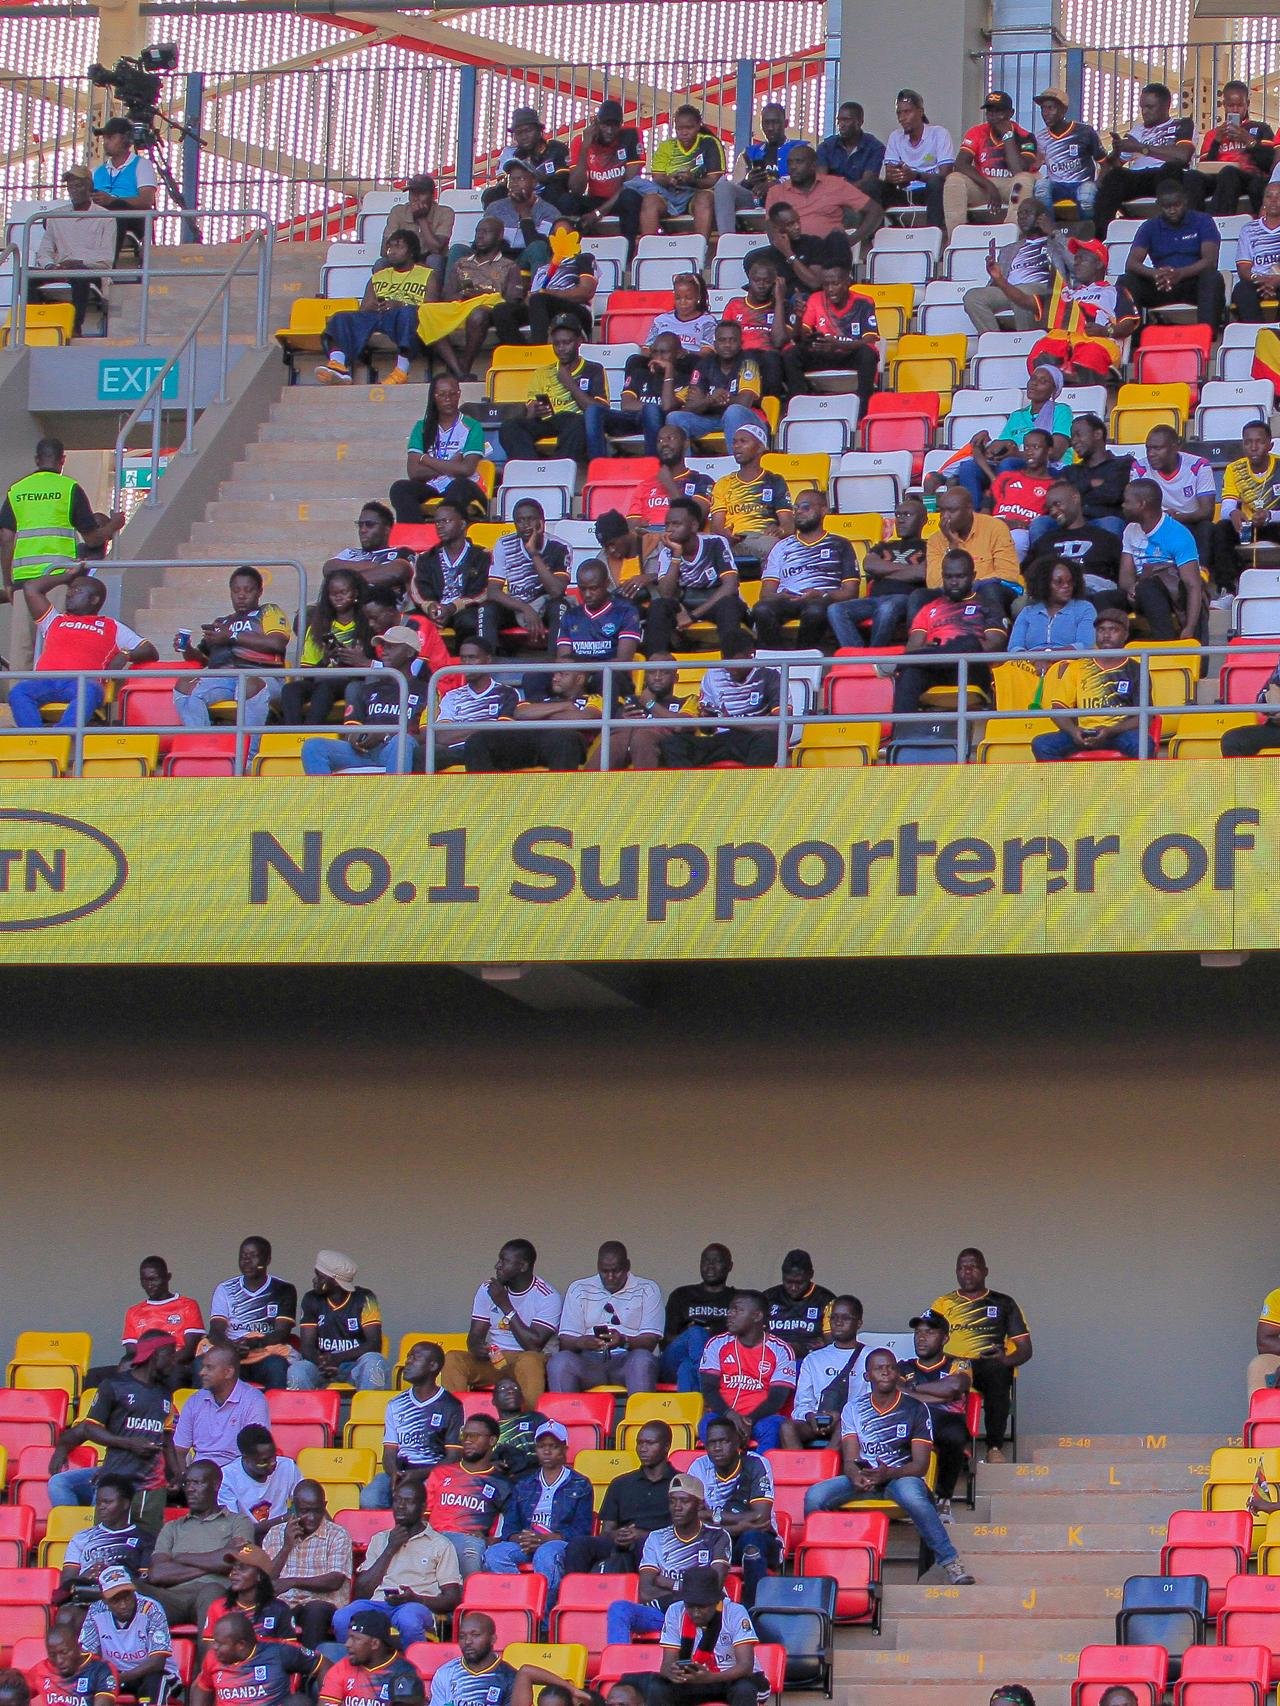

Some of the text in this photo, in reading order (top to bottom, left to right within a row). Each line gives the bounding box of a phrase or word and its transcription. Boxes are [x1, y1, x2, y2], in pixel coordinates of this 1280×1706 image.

[102, 365, 170, 394] EXIT
[369, 388, 385, 403] G
[336, 443, 349, 463] F
[16, 491, 62, 502] STEWARD
[298, 502, 309, 521] E
[59, 622, 105, 635] UGANDA
[368, 704, 412, 719] UGANA
[248, 826, 481, 906] No.1
[1140, 806, 1260, 894] of
[769, 1320, 815, 1332] UGANDA
[127, 1417, 164, 1432] UGAND
[1146, 1435, 1168, 1449] M
[1108, 1467, 1121, 1485] L
[440, 1493, 485, 1512] UGANDA
[1067, 1526, 1084, 1546] K
[1023, 1589, 1037, 1610] J
